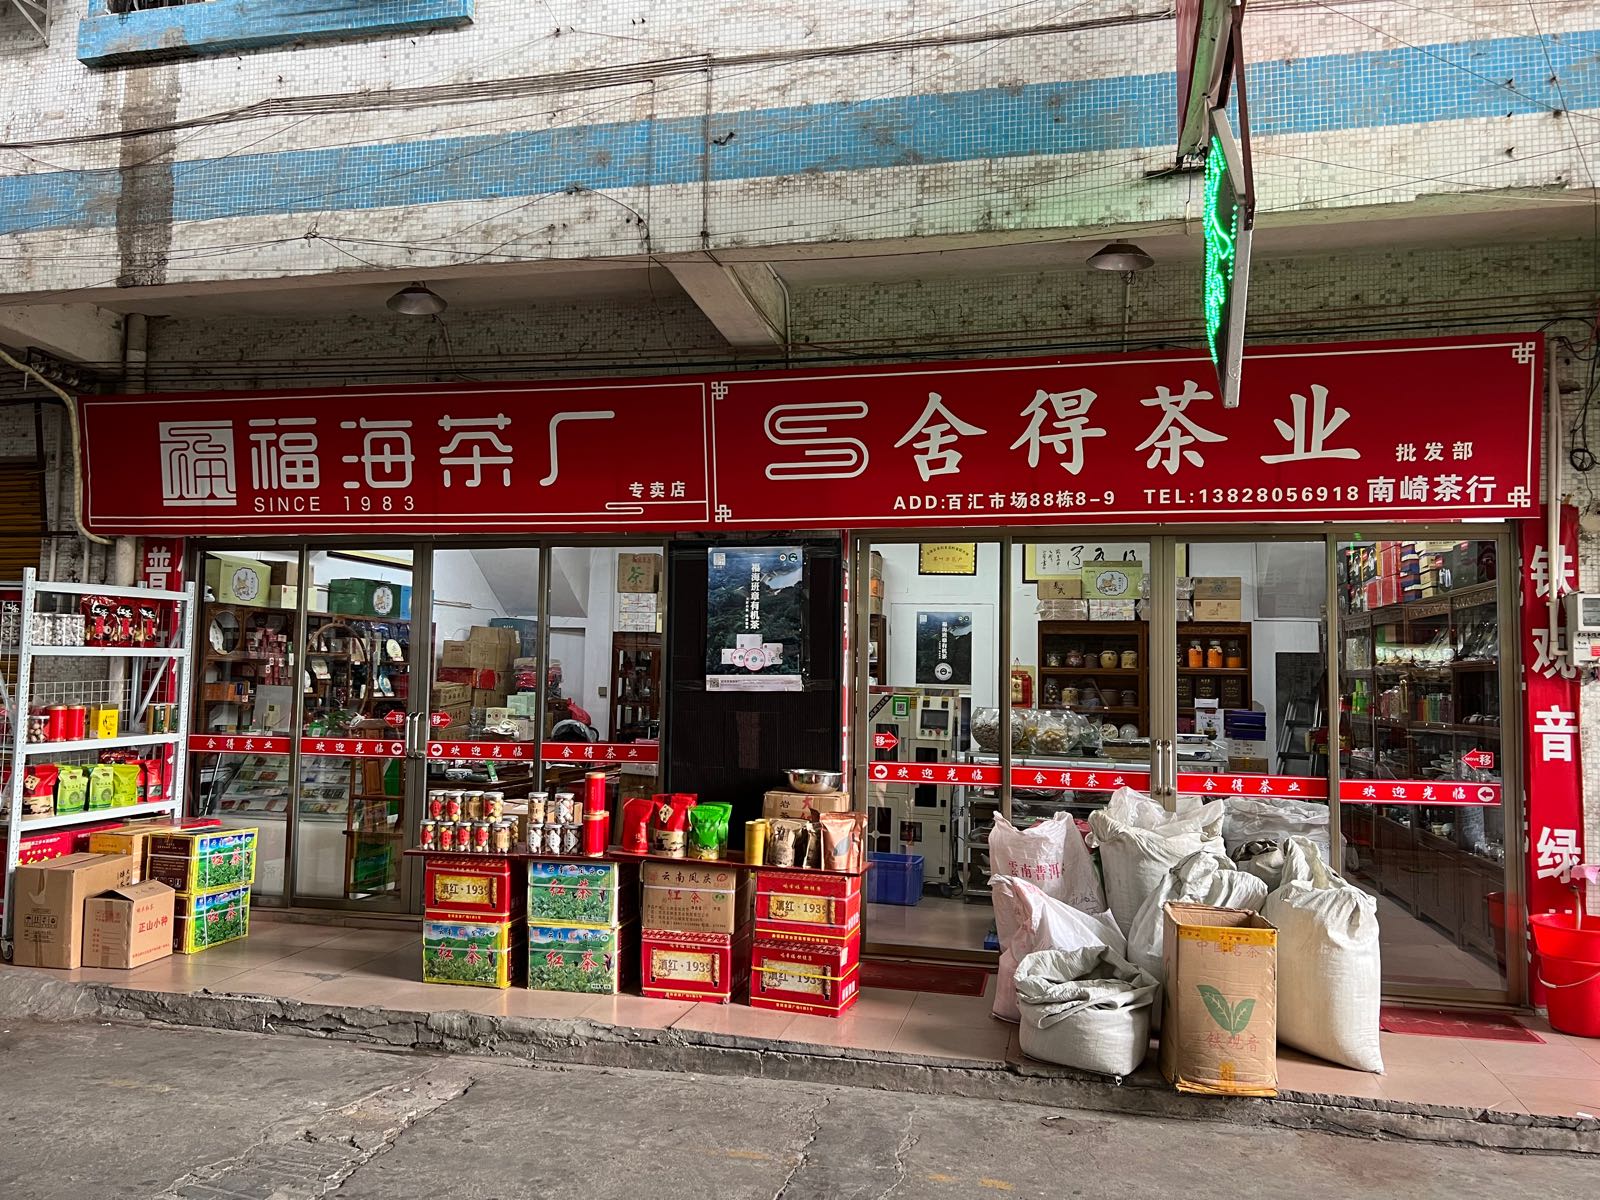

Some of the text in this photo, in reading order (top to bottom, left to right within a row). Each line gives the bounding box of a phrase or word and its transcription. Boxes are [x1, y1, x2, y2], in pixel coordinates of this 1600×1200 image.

[894, 380, 1361, 482] 舍得茶业
[248, 410, 615, 490] 福海茶厂
[1395, 441, 1473, 462] 批发部
[629, 481, 685, 498] 专卖店
[1144, 486, 1360, 505] TEL:13828056918
[1367, 474, 1497, 503] 南崎茶行
[254, 495, 415, 512] SINCE 1983
[206, 738, 273, 750] 舍得茶业
[315, 741, 385, 754] 欢迎光临
[875, 736, 885, 746] 移
[450, 745, 523, 758] 欢迎光临
[561, 746, 639, 758] 舍得茶业
[1480, 754, 1492, 766] 移
[897, 767, 984, 781] 欢迎光临
[1033, 772, 1126, 787] 舍得茶业
[1203, 777, 1301, 793] 舍得茶业
[1363, 784, 1466, 800] 欢迎光临
[662, 871, 712, 884] 云南凤庆
[1008, 861, 1065, 881] 雲南普洱
[549, 879, 593, 901] 红茶
[438, 942, 483, 966] 红茶
[546, 949, 599, 973] 红茶
